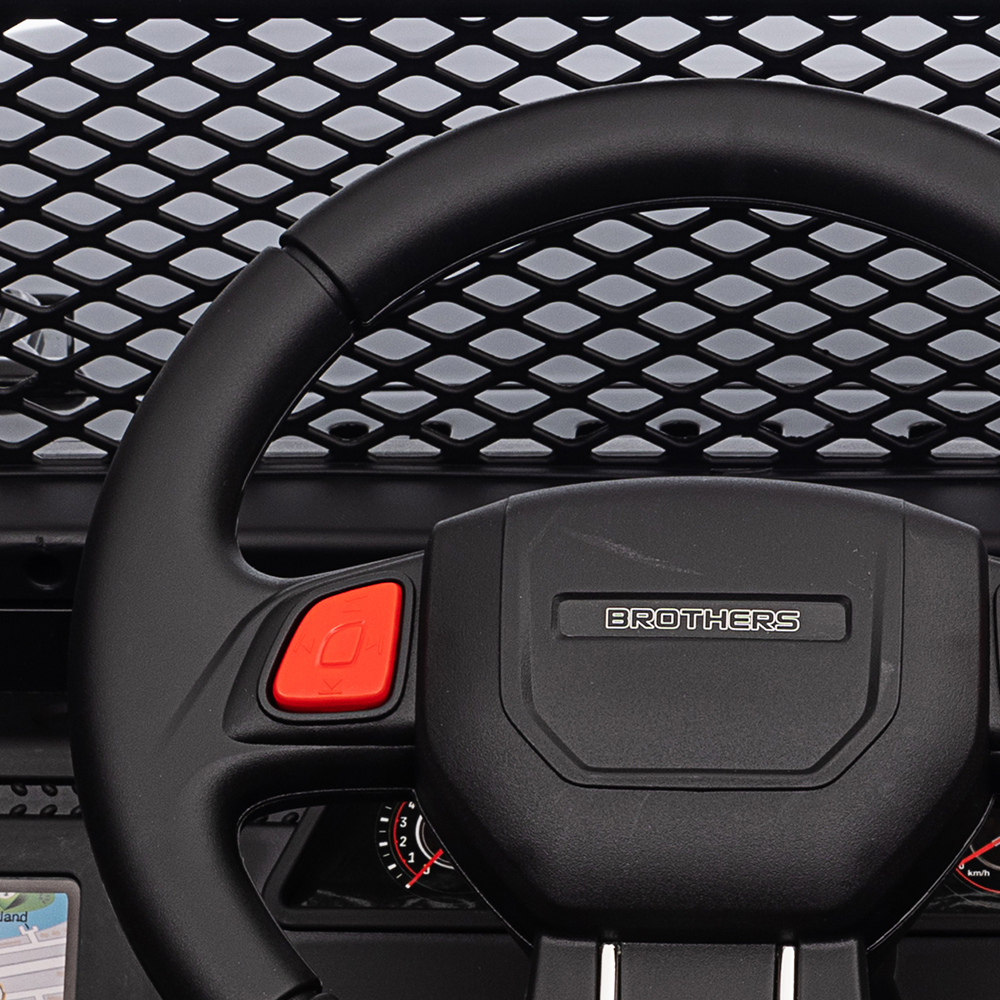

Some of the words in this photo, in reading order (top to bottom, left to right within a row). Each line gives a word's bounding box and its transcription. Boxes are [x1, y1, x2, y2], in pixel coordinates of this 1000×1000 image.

[605, 607, 801, 632] BROTHERS
[400, 816, 408, 828] 3
[399, 836, 407, 847] 2
[407, 852, 415, 863] 1
[967, 869, 991, 877] km/h
